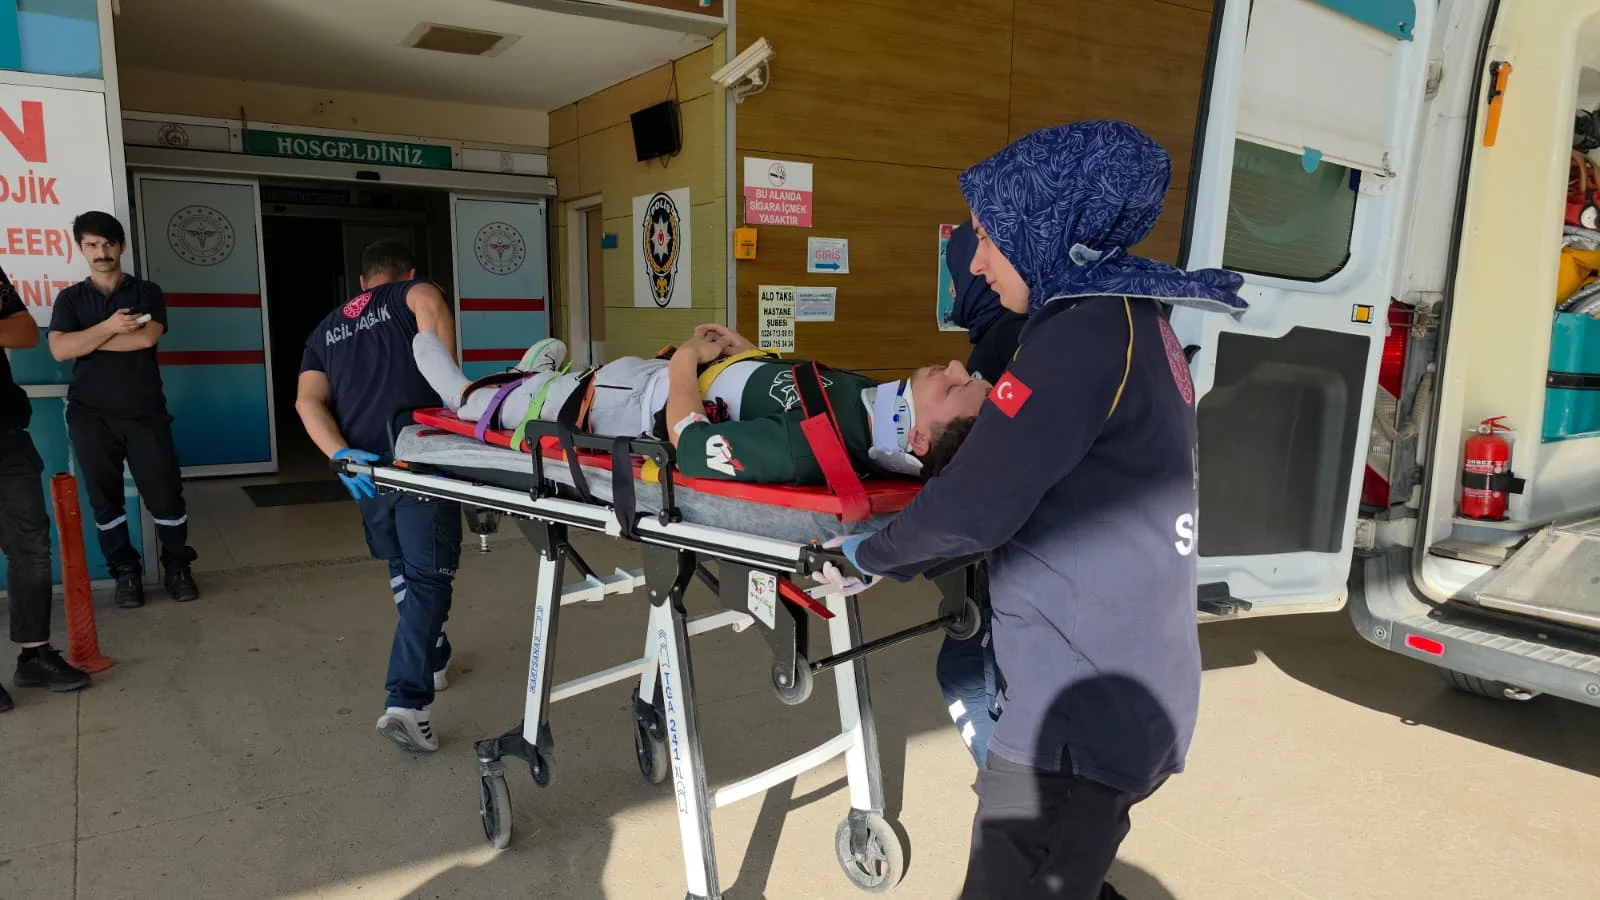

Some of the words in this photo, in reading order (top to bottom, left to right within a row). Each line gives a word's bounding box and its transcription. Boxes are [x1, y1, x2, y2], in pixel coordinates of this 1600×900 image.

[755, 189, 768, 199] BU
[769, 190, 802, 202] ALANDA
[750, 200, 781, 212] SİGARA
[782, 201, 807, 215] İÇMEK
[759, 214, 798, 226] YASAKTIR
[0, 228, 73, 264] EER)
[761, 291, 775, 302] ALO
[763, 307, 791, 316] HASTANE
[325, 323, 353, 346] ACİL
